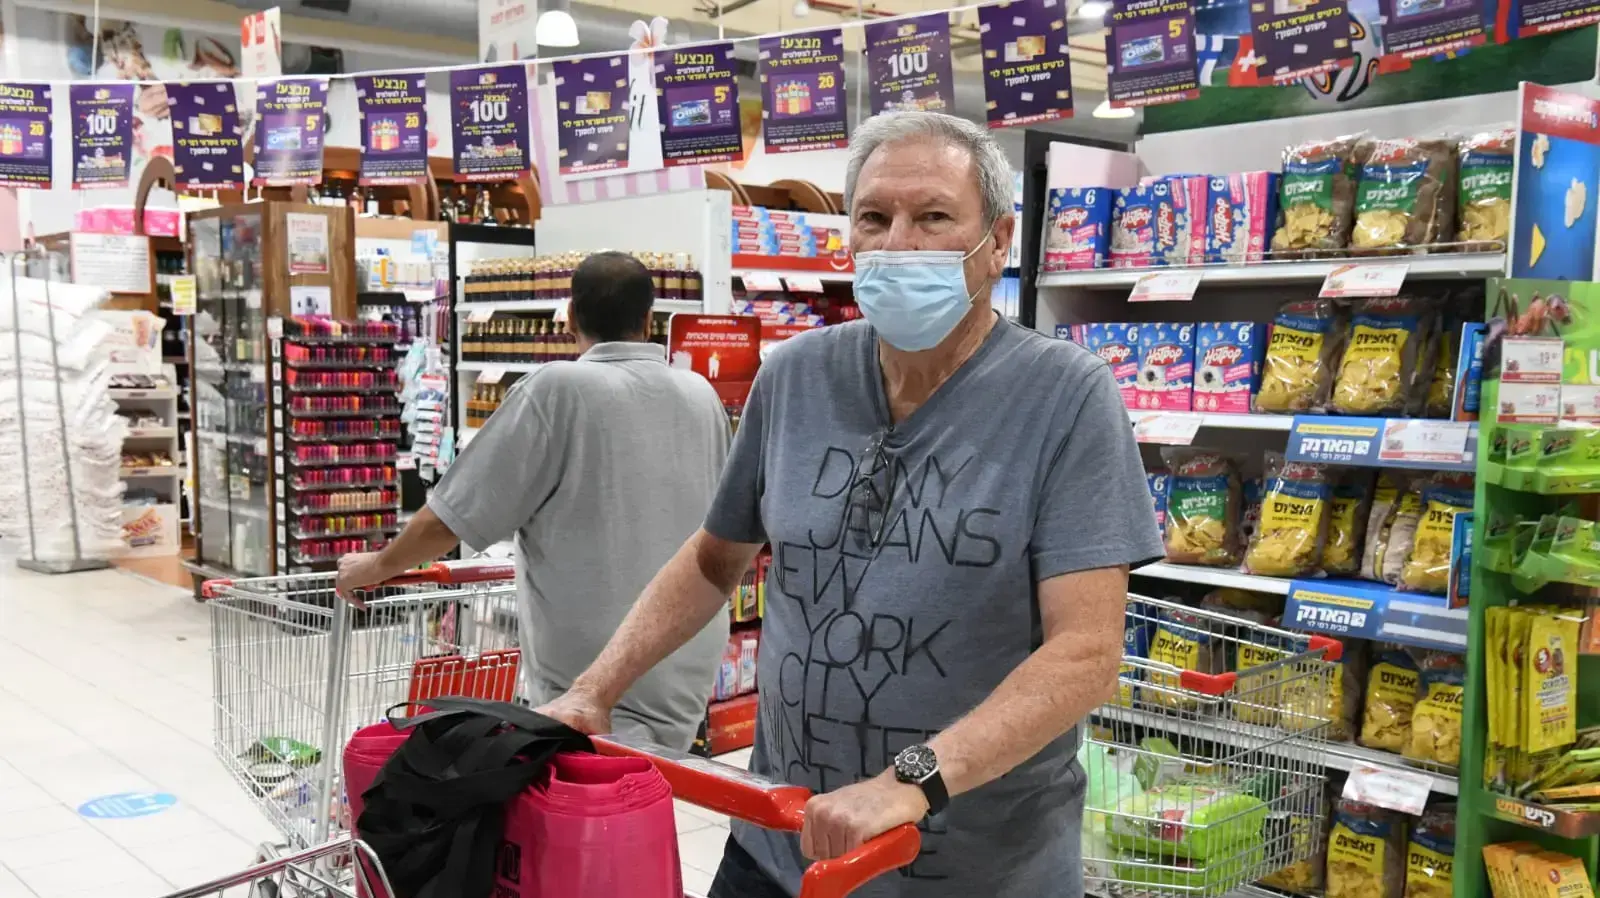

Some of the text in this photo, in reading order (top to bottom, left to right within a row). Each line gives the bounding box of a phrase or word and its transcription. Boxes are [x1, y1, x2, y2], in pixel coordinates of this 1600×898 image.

[675, 53, 714, 65] מבצע!
[888, 52, 928, 78] 100
[818, 75, 834, 89] 20
[470, 100, 507, 122] 100
[30, 124, 44, 136] 20
[87, 115, 116, 135] 100
[1085, 189, 1096, 205] 6
[1127, 326, 1138, 342] 6
[1179, 326, 1191, 341] 6
[1238, 325, 1250, 341] 6
[1299, 438, 1355, 454] הארנק
[1153, 476, 1165, 491] 6
[808, 500, 1001, 567] JEANS
[1296, 605, 1351, 625] הארנק
[799, 597, 952, 678] YORK
[779, 651, 892, 724] CITY
